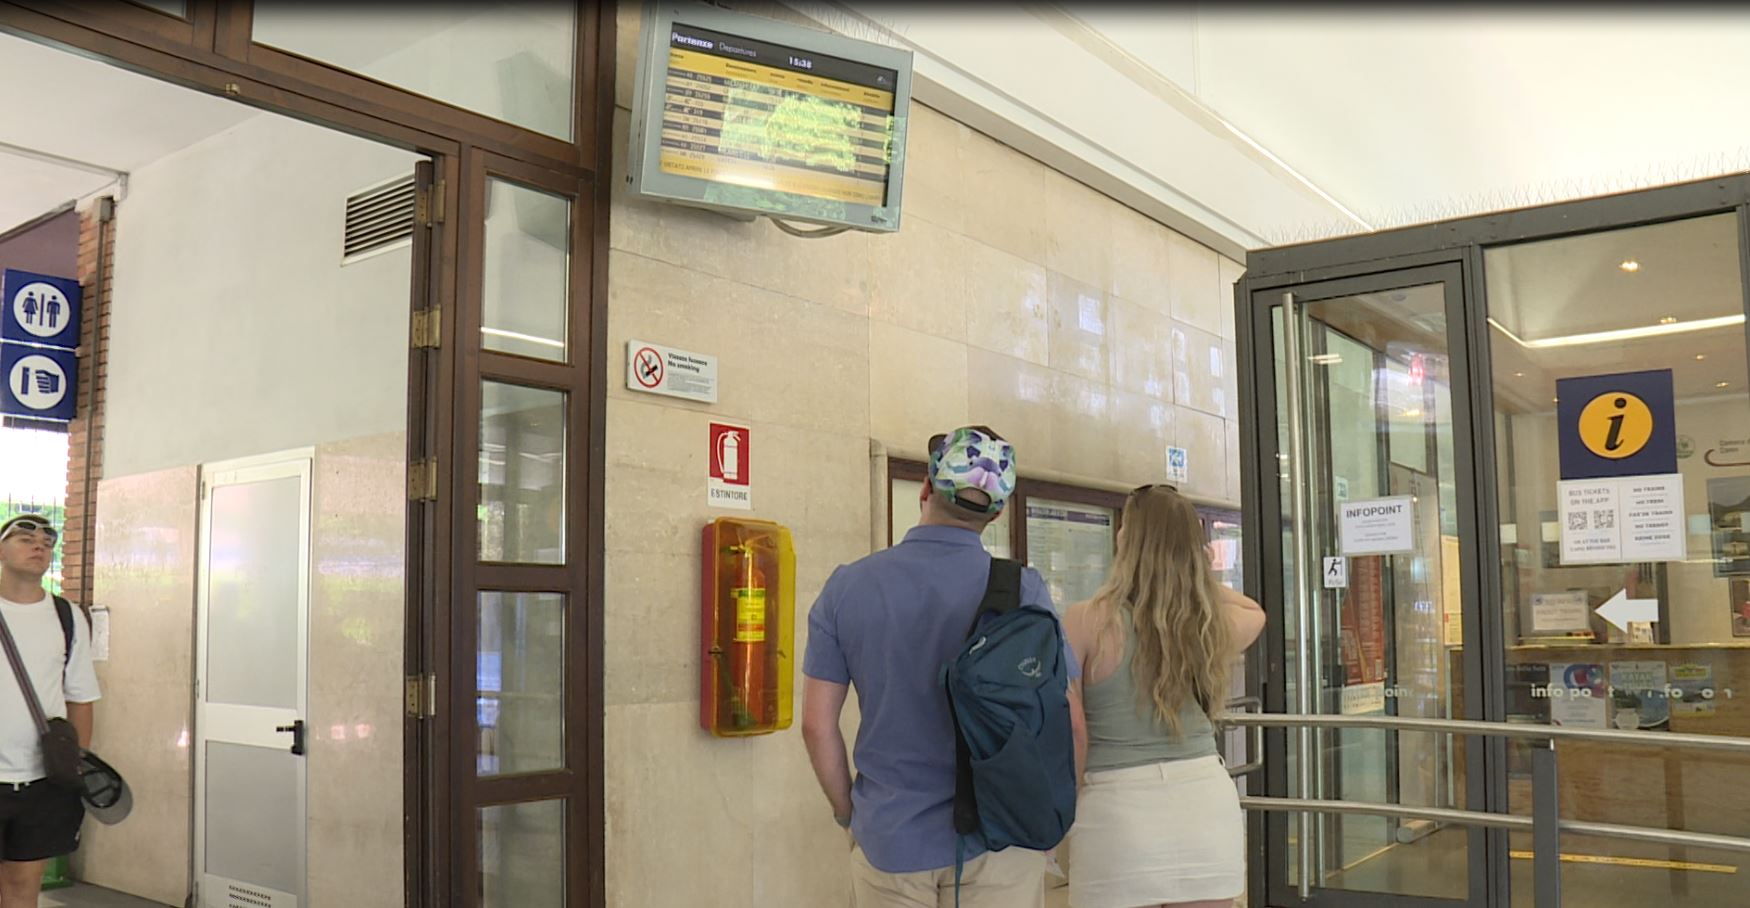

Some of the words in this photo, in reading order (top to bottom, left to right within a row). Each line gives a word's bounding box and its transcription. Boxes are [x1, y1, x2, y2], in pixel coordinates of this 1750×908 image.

[719, 42, 756, 57] Departures
[677, 363, 700, 373] smoking
[711, 488, 748, 501] ESTINTORE
[1583, 488, 1610, 496] TICKETS
[1346, 504, 1403, 518] INFOPOINT
[1531, 683, 1563, 698] info
[1569, 684, 1615, 701] pot
